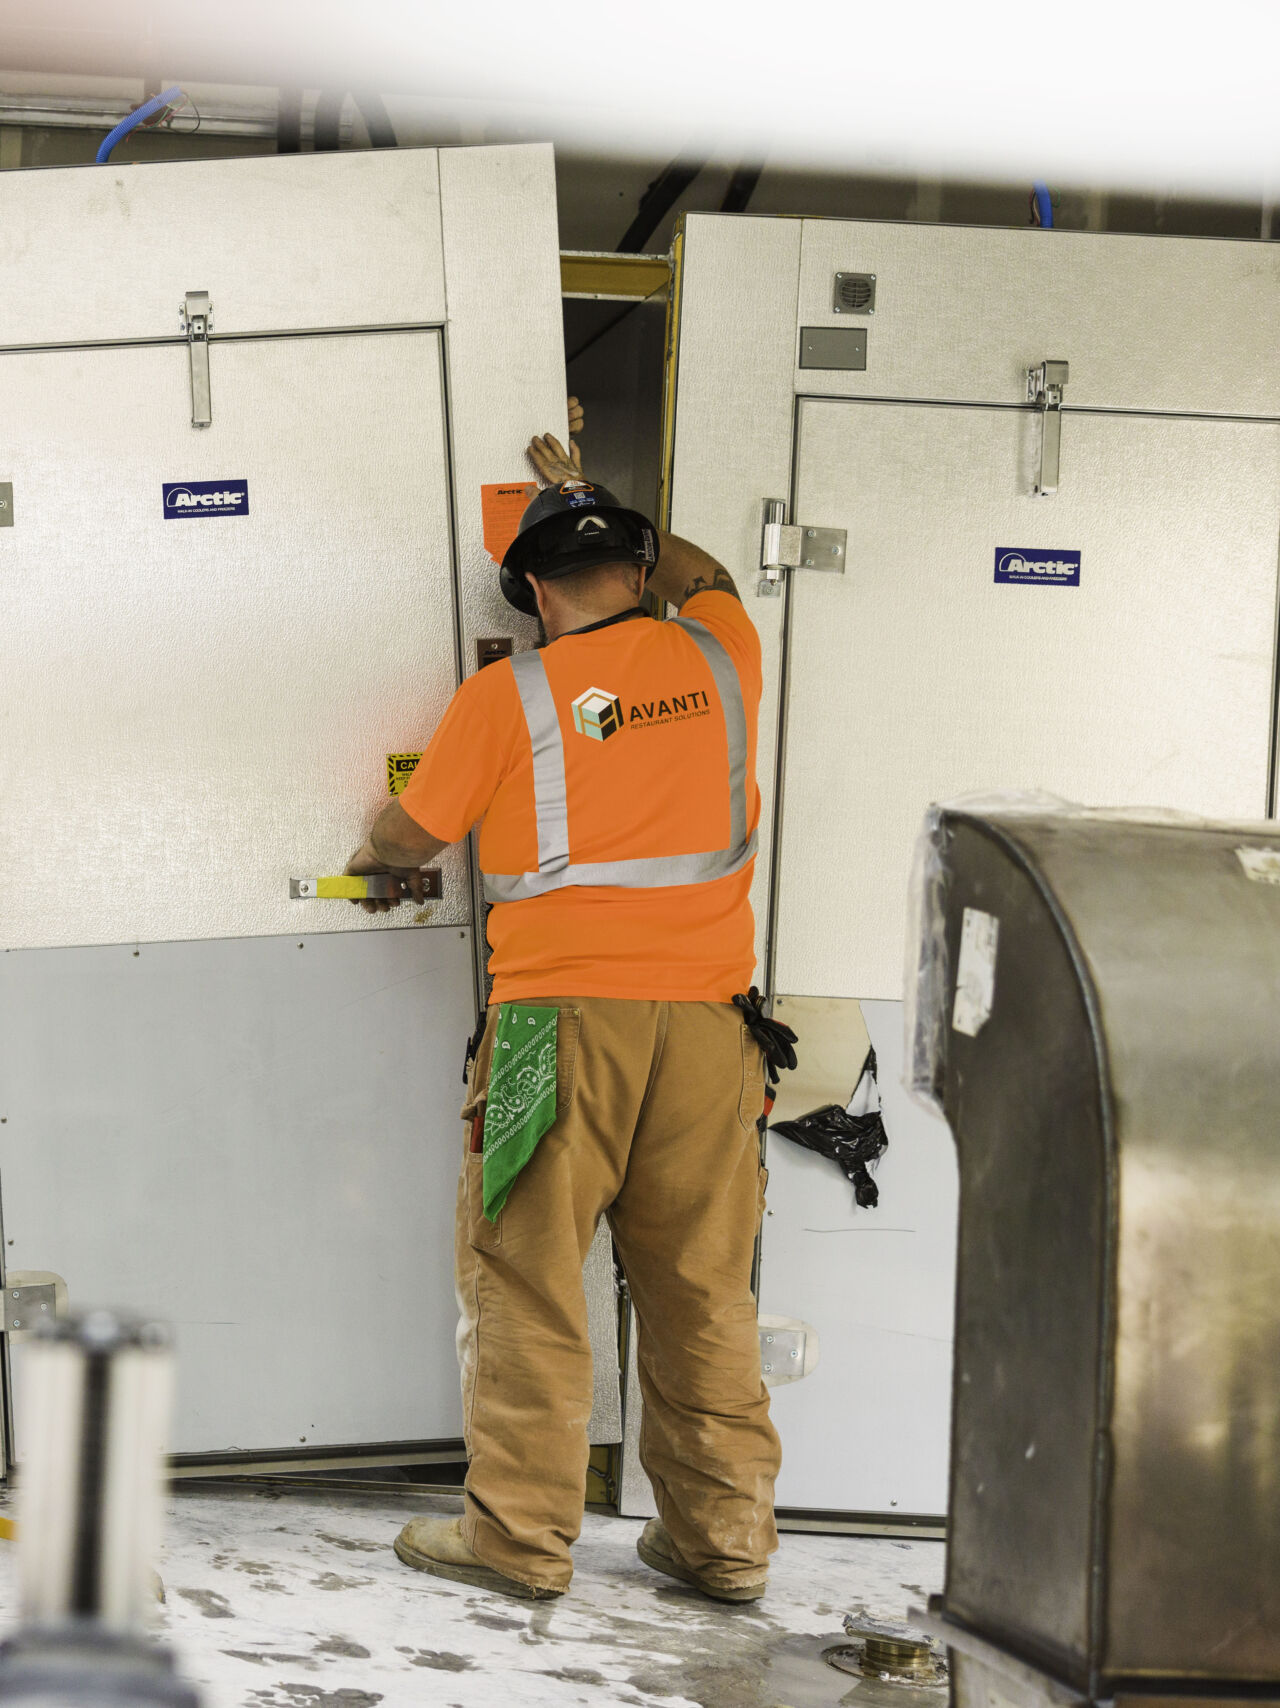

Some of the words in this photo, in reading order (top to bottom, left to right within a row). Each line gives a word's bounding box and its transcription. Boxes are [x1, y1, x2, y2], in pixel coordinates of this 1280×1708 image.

[175, 491, 242, 507] Arctic
[1007, 558, 1075, 575] Arctic
[630, 691, 709, 722] AVANTI
[630, 717, 672, 730] RESTAURANT
[673, 709, 711, 722] SOLUTIONS
